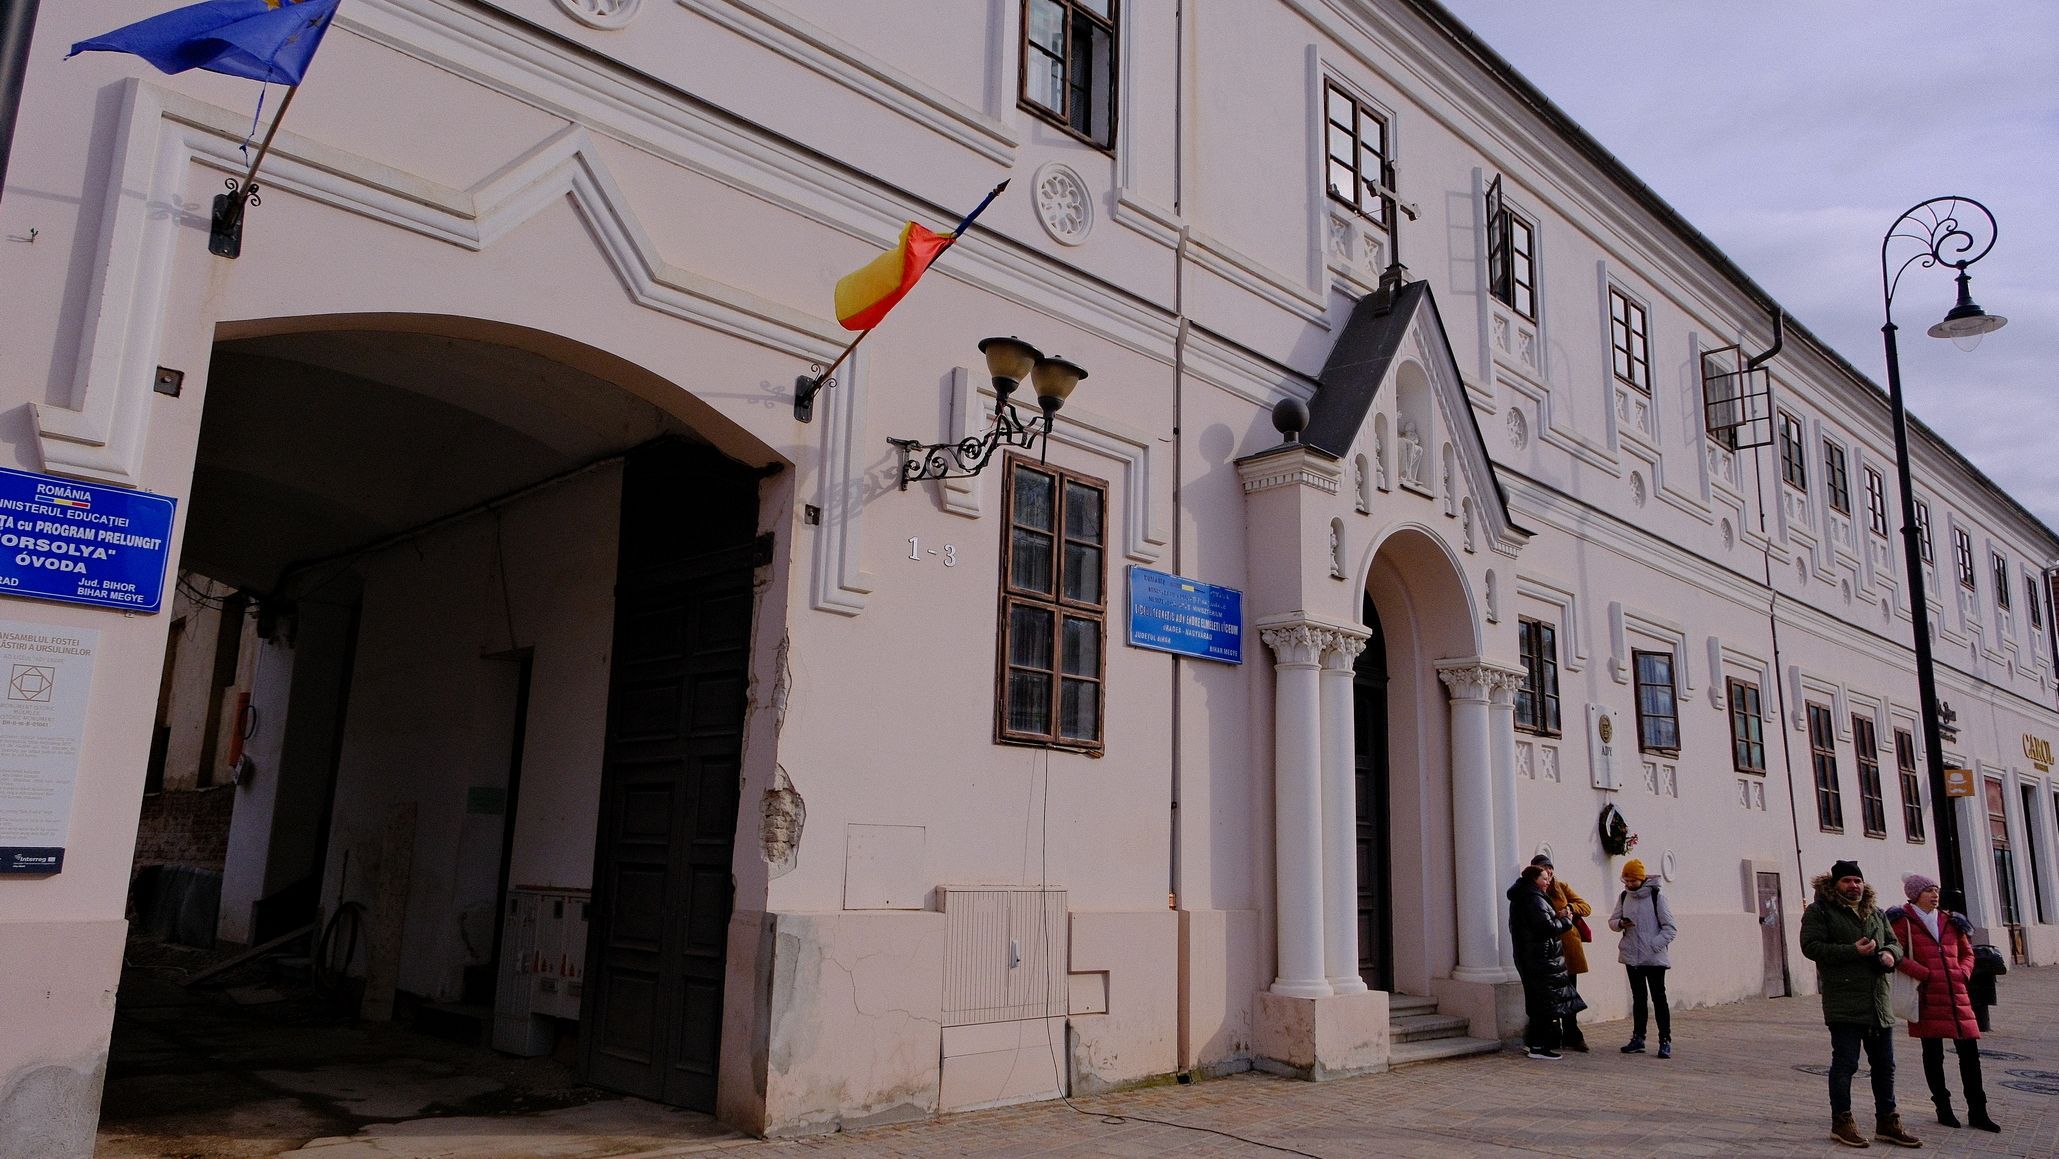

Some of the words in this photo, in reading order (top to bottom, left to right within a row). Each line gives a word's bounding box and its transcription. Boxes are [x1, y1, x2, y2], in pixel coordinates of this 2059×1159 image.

[36, 484, 92, 501] ROMÂNIA
[0, 498, 64, 517] INISTERUL
[0, 514, 14, 530] ȚA
[17, 520, 33, 531] cu
[35, 521, 95, 541] PROGRAM
[97, 530, 161, 550] PRELUNGIT
[15, 551, 87, 574] ÓVODA
[0, 576, 19, 586] RAD
[78, 577, 100, 588] Jud.
[102, 580, 136, 592] BIHOR
[77, 587, 108, 599] BIHAR
[110, 591, 144, 603] MEGYE
[51, 637, 80, 647] FOSTEI
[36, 645, 91, 656] URSULINELOR
